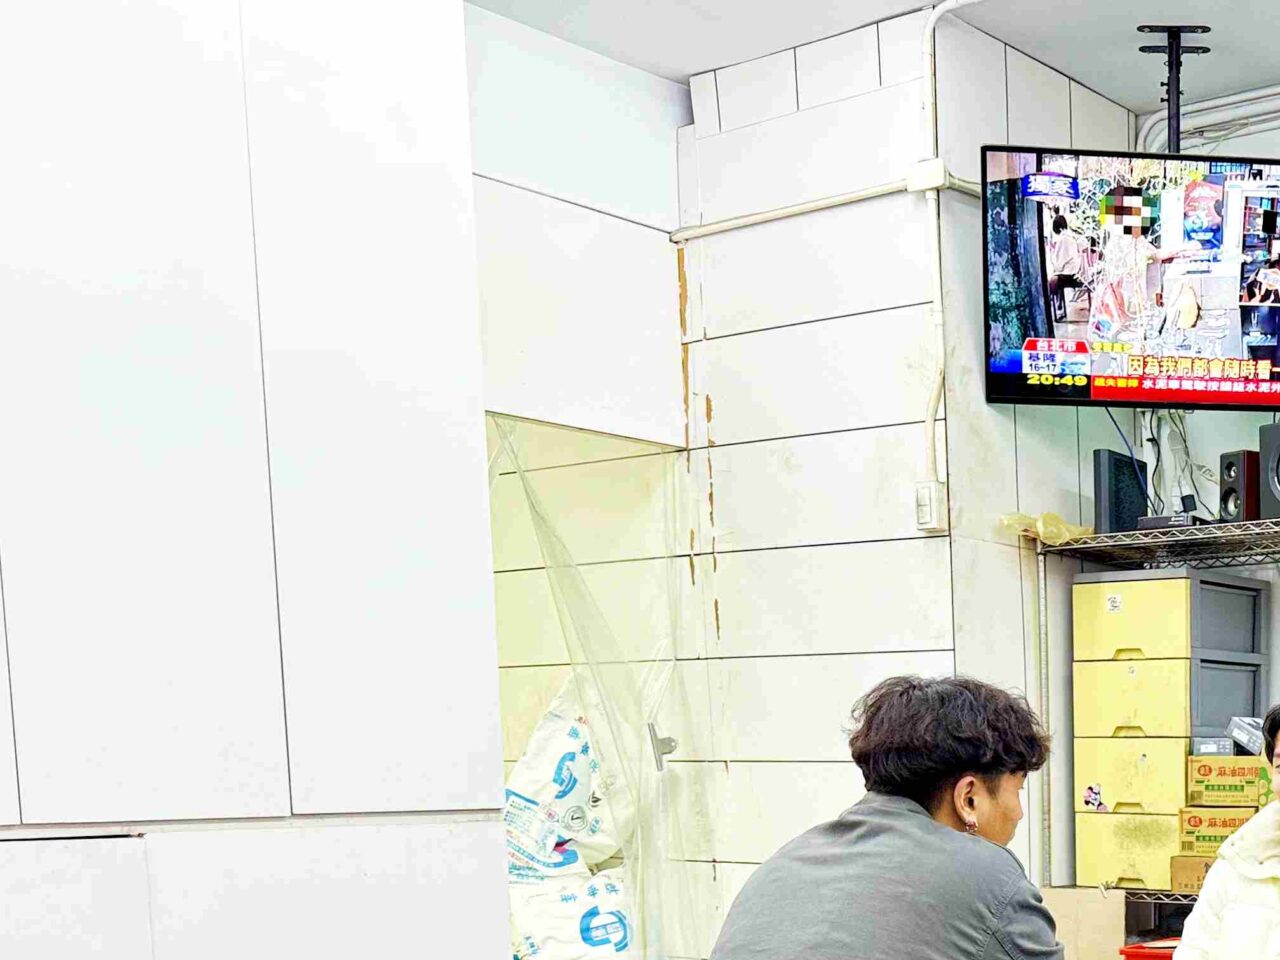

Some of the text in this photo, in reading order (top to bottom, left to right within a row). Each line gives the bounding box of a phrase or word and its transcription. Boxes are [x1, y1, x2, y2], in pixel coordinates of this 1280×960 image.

[1036, 339, 1077, 351] 台北市
[1027, 352, 1056, 362] 基隆
[1027, 374, 1088, 386] 20:49
